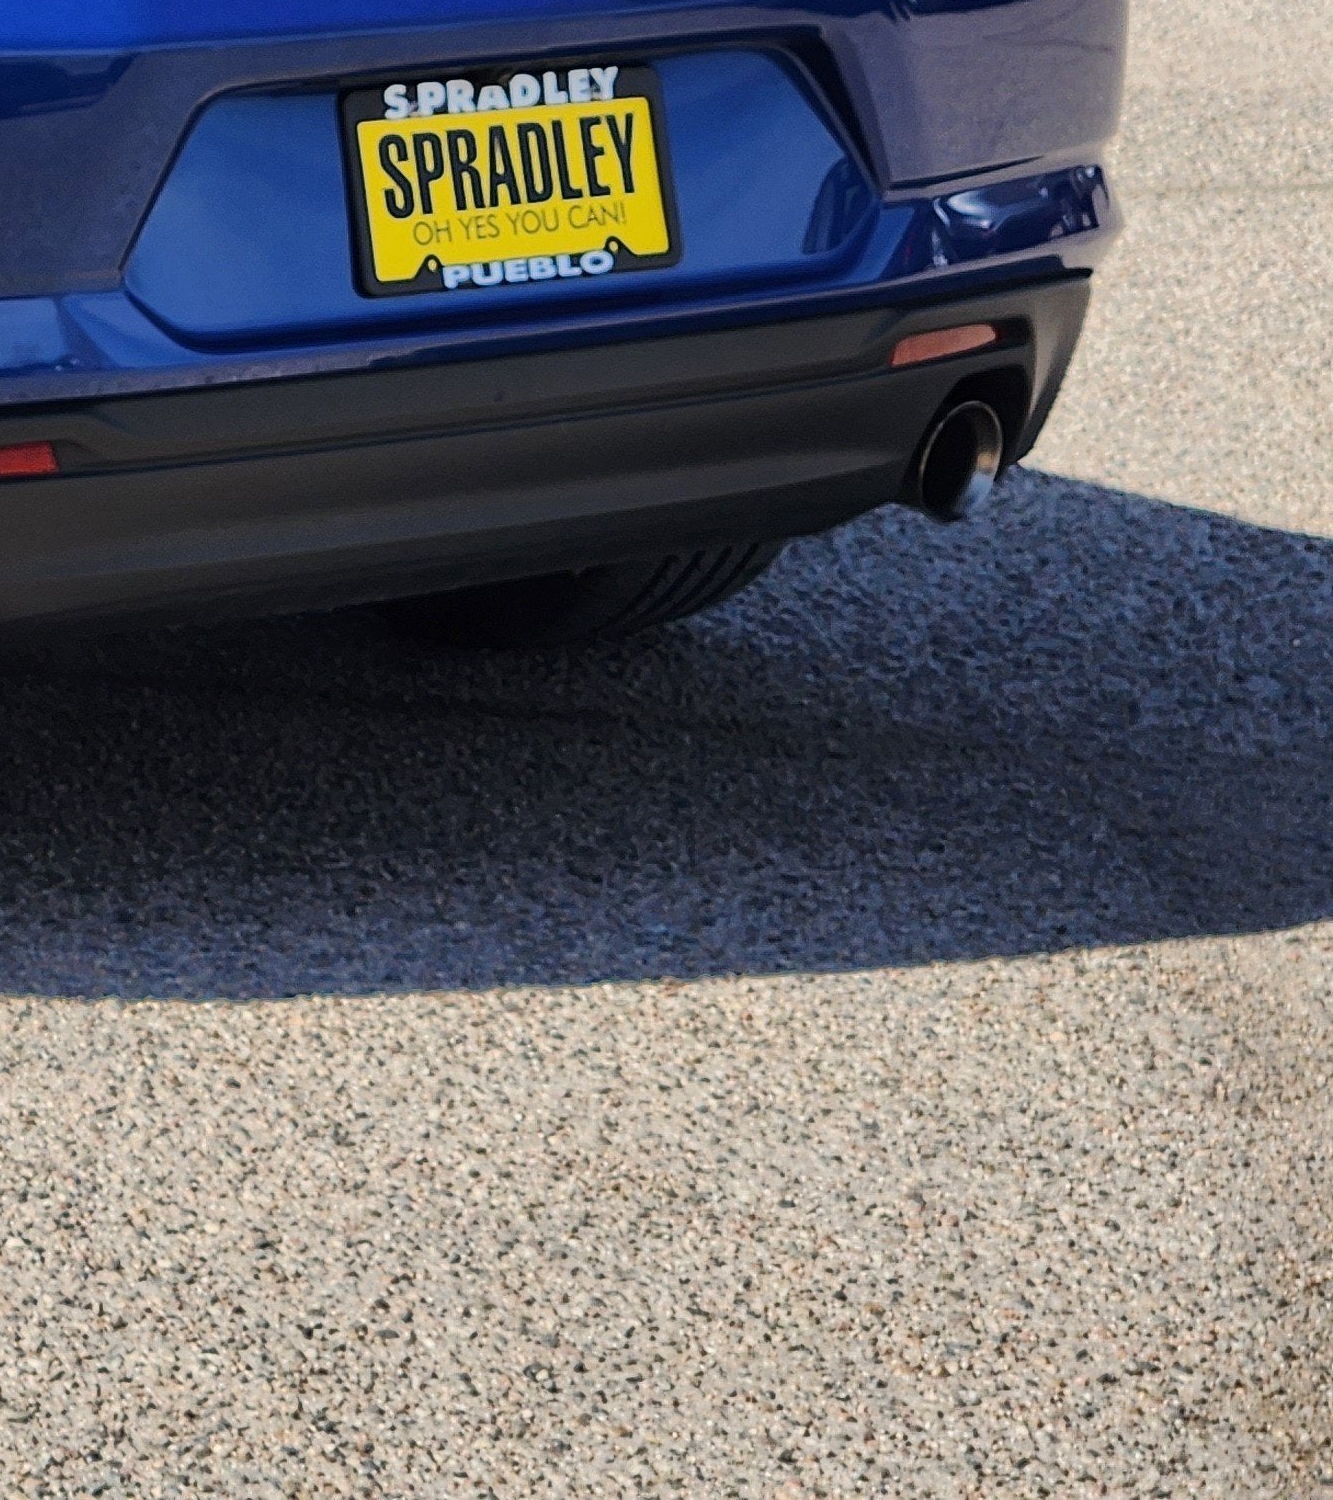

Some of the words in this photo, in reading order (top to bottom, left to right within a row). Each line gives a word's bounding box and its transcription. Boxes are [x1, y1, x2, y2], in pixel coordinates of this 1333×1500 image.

[378, 111, 636, 219] SPRADLEY
[413, 220, 453, 246] OH
[457, 213, 500, 240] YES
[505, 207, 560, 235] YOU
[568, 201, 627, 229] CAN!
[441, 249, 615, 290] PUEBLO
